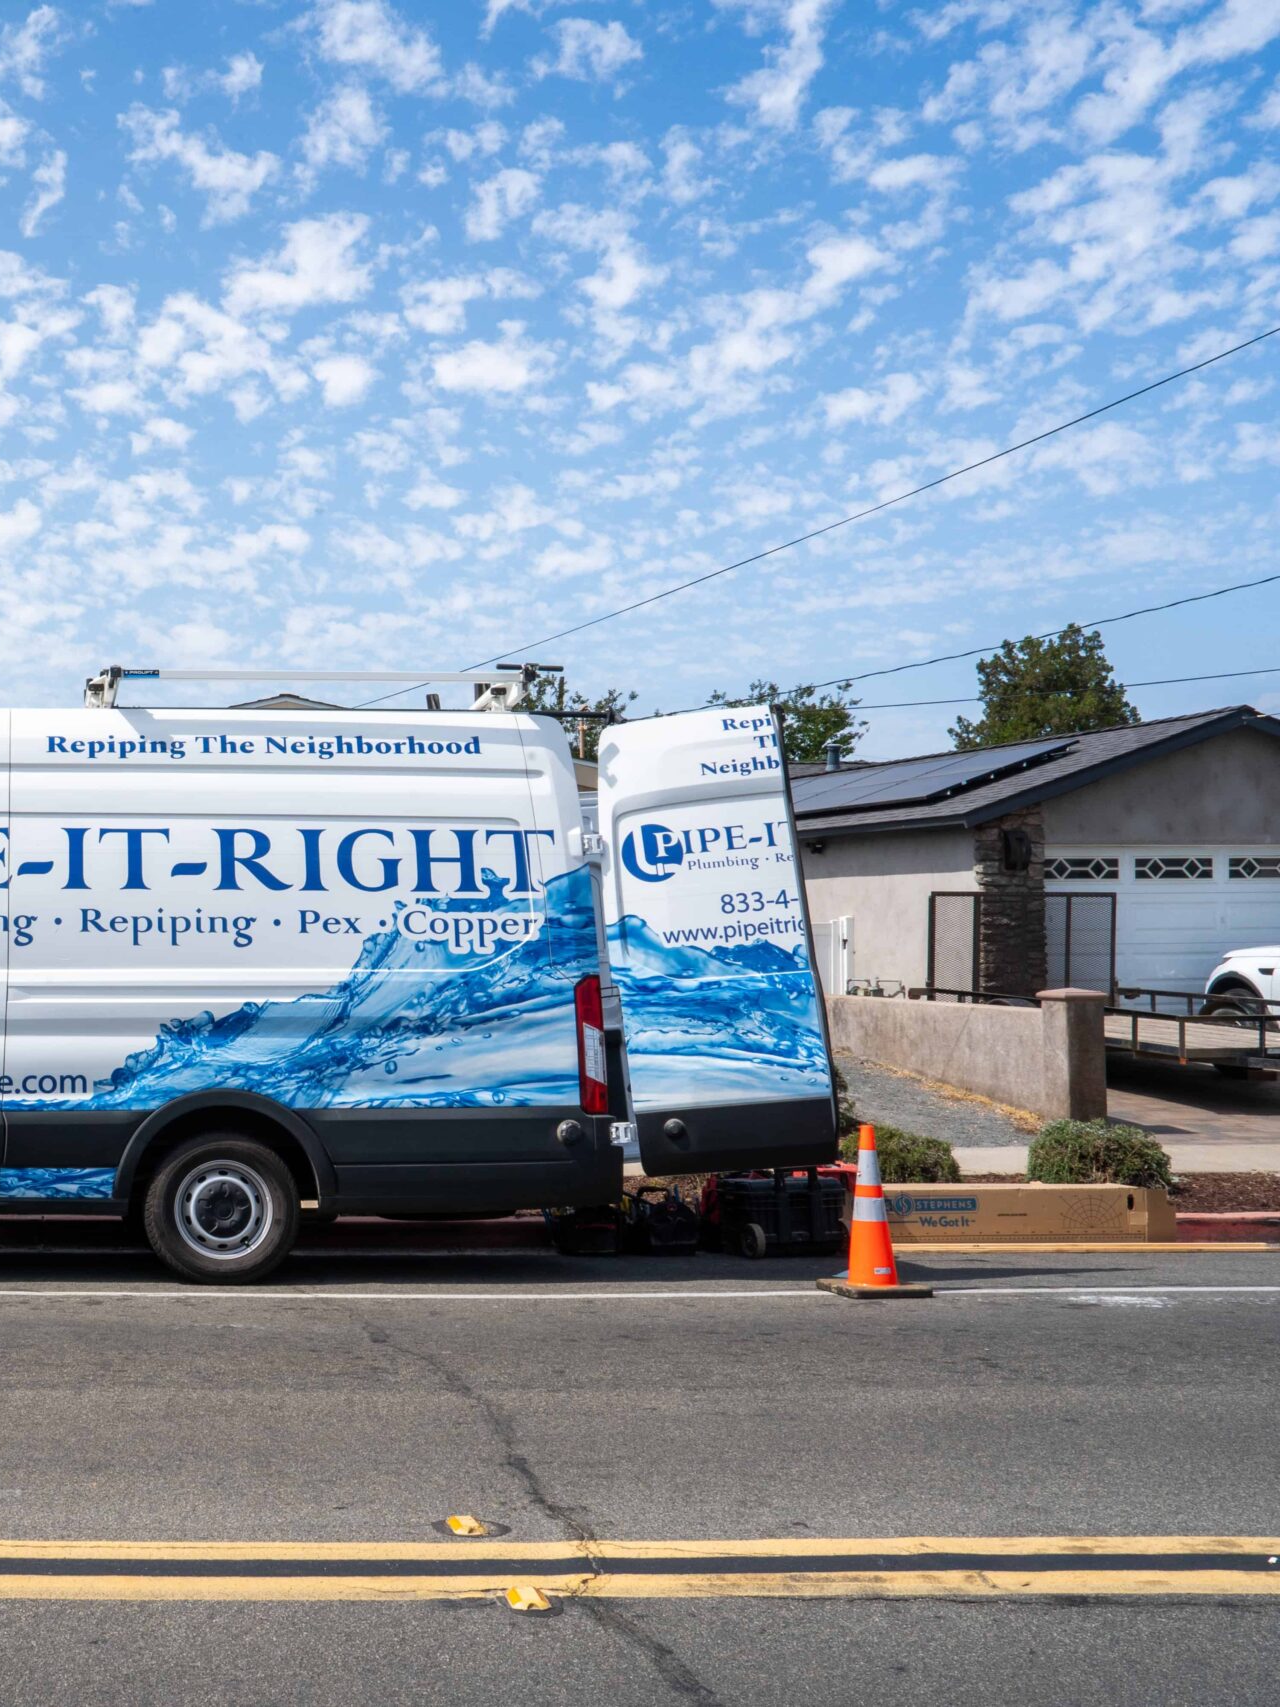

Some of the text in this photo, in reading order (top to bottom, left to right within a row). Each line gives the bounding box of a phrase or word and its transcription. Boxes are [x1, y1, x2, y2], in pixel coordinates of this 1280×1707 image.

[47, 734, 483, 760] Repiping The Neighborhood
[700, 755, 780, 776] Neighb
[688, 856, 759, 870] Plumbing
[80, 908, 257, 947] Repiping
[298, 909, 362, 935] Pex
[403, 910, 538, 948] Copper
[916, 1200, 973, 1209] STEPHENS
[919, 1216, 970, 1227] We Got It
